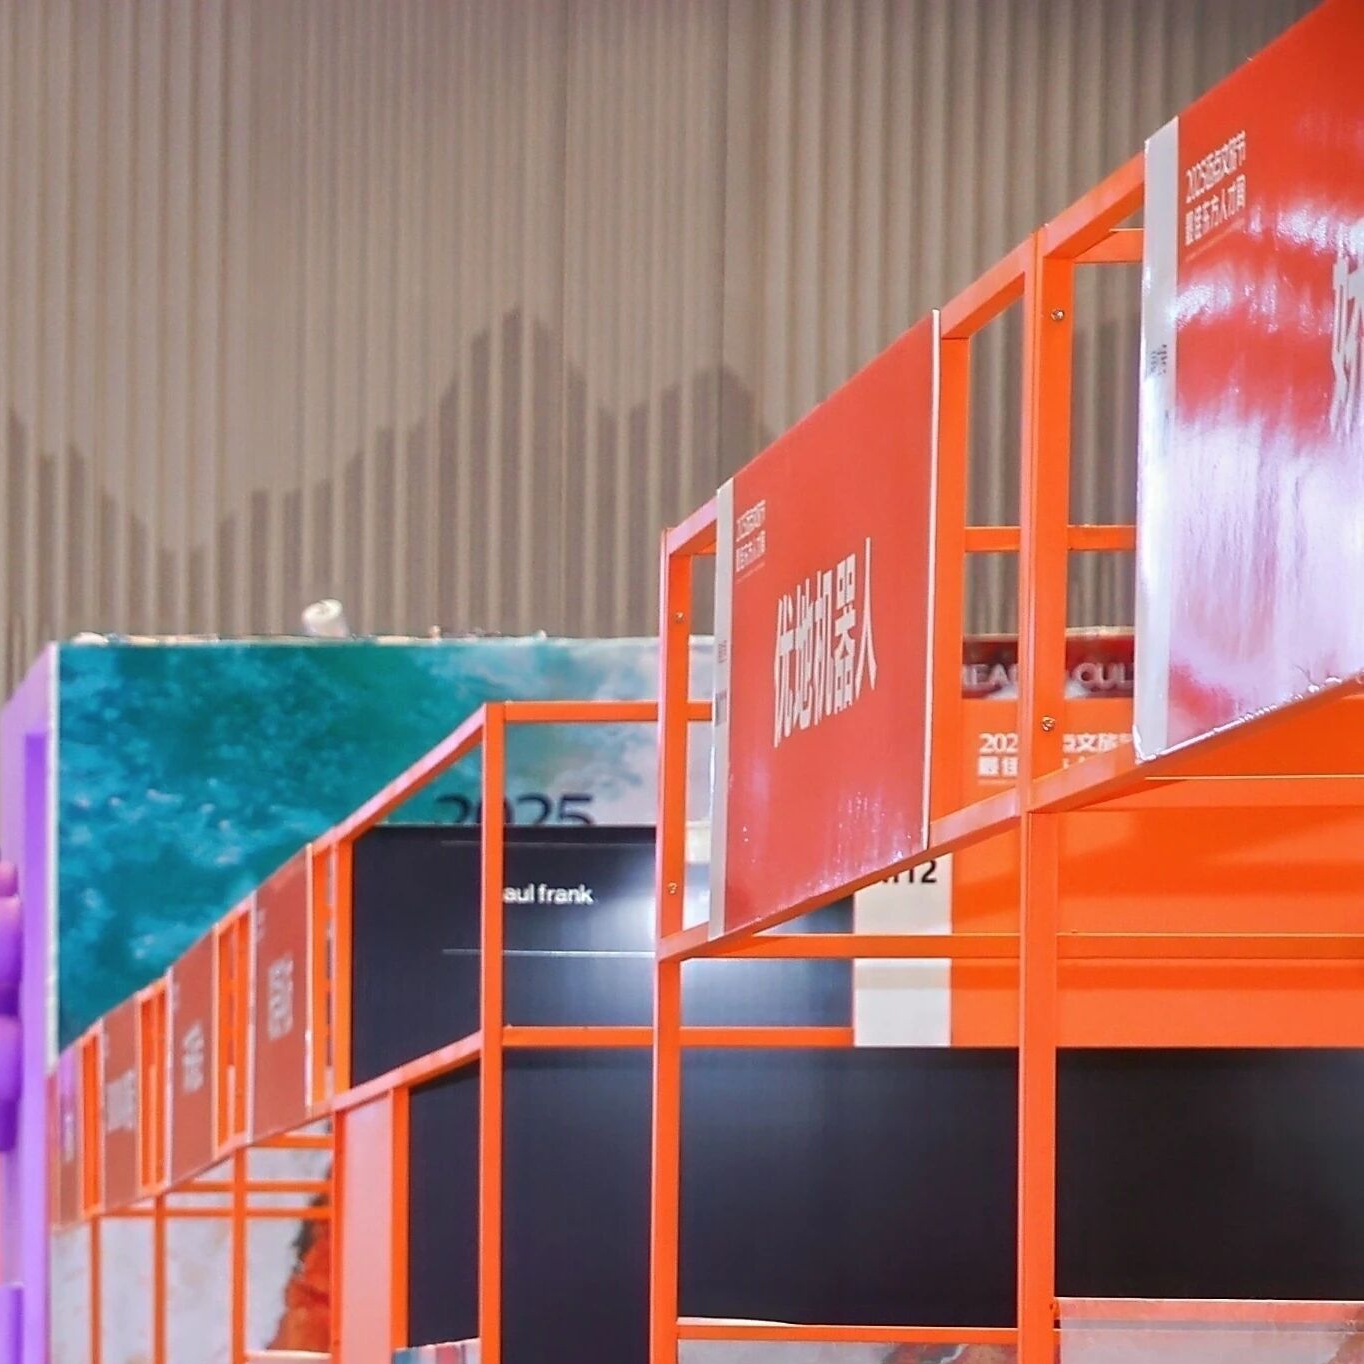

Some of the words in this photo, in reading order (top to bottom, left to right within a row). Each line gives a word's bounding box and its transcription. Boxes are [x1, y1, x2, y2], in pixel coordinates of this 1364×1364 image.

[774, 536, 878, 748] 优地机器人
[503, 884, 535, 905] aul
[537, 883, 594, 905] frank
